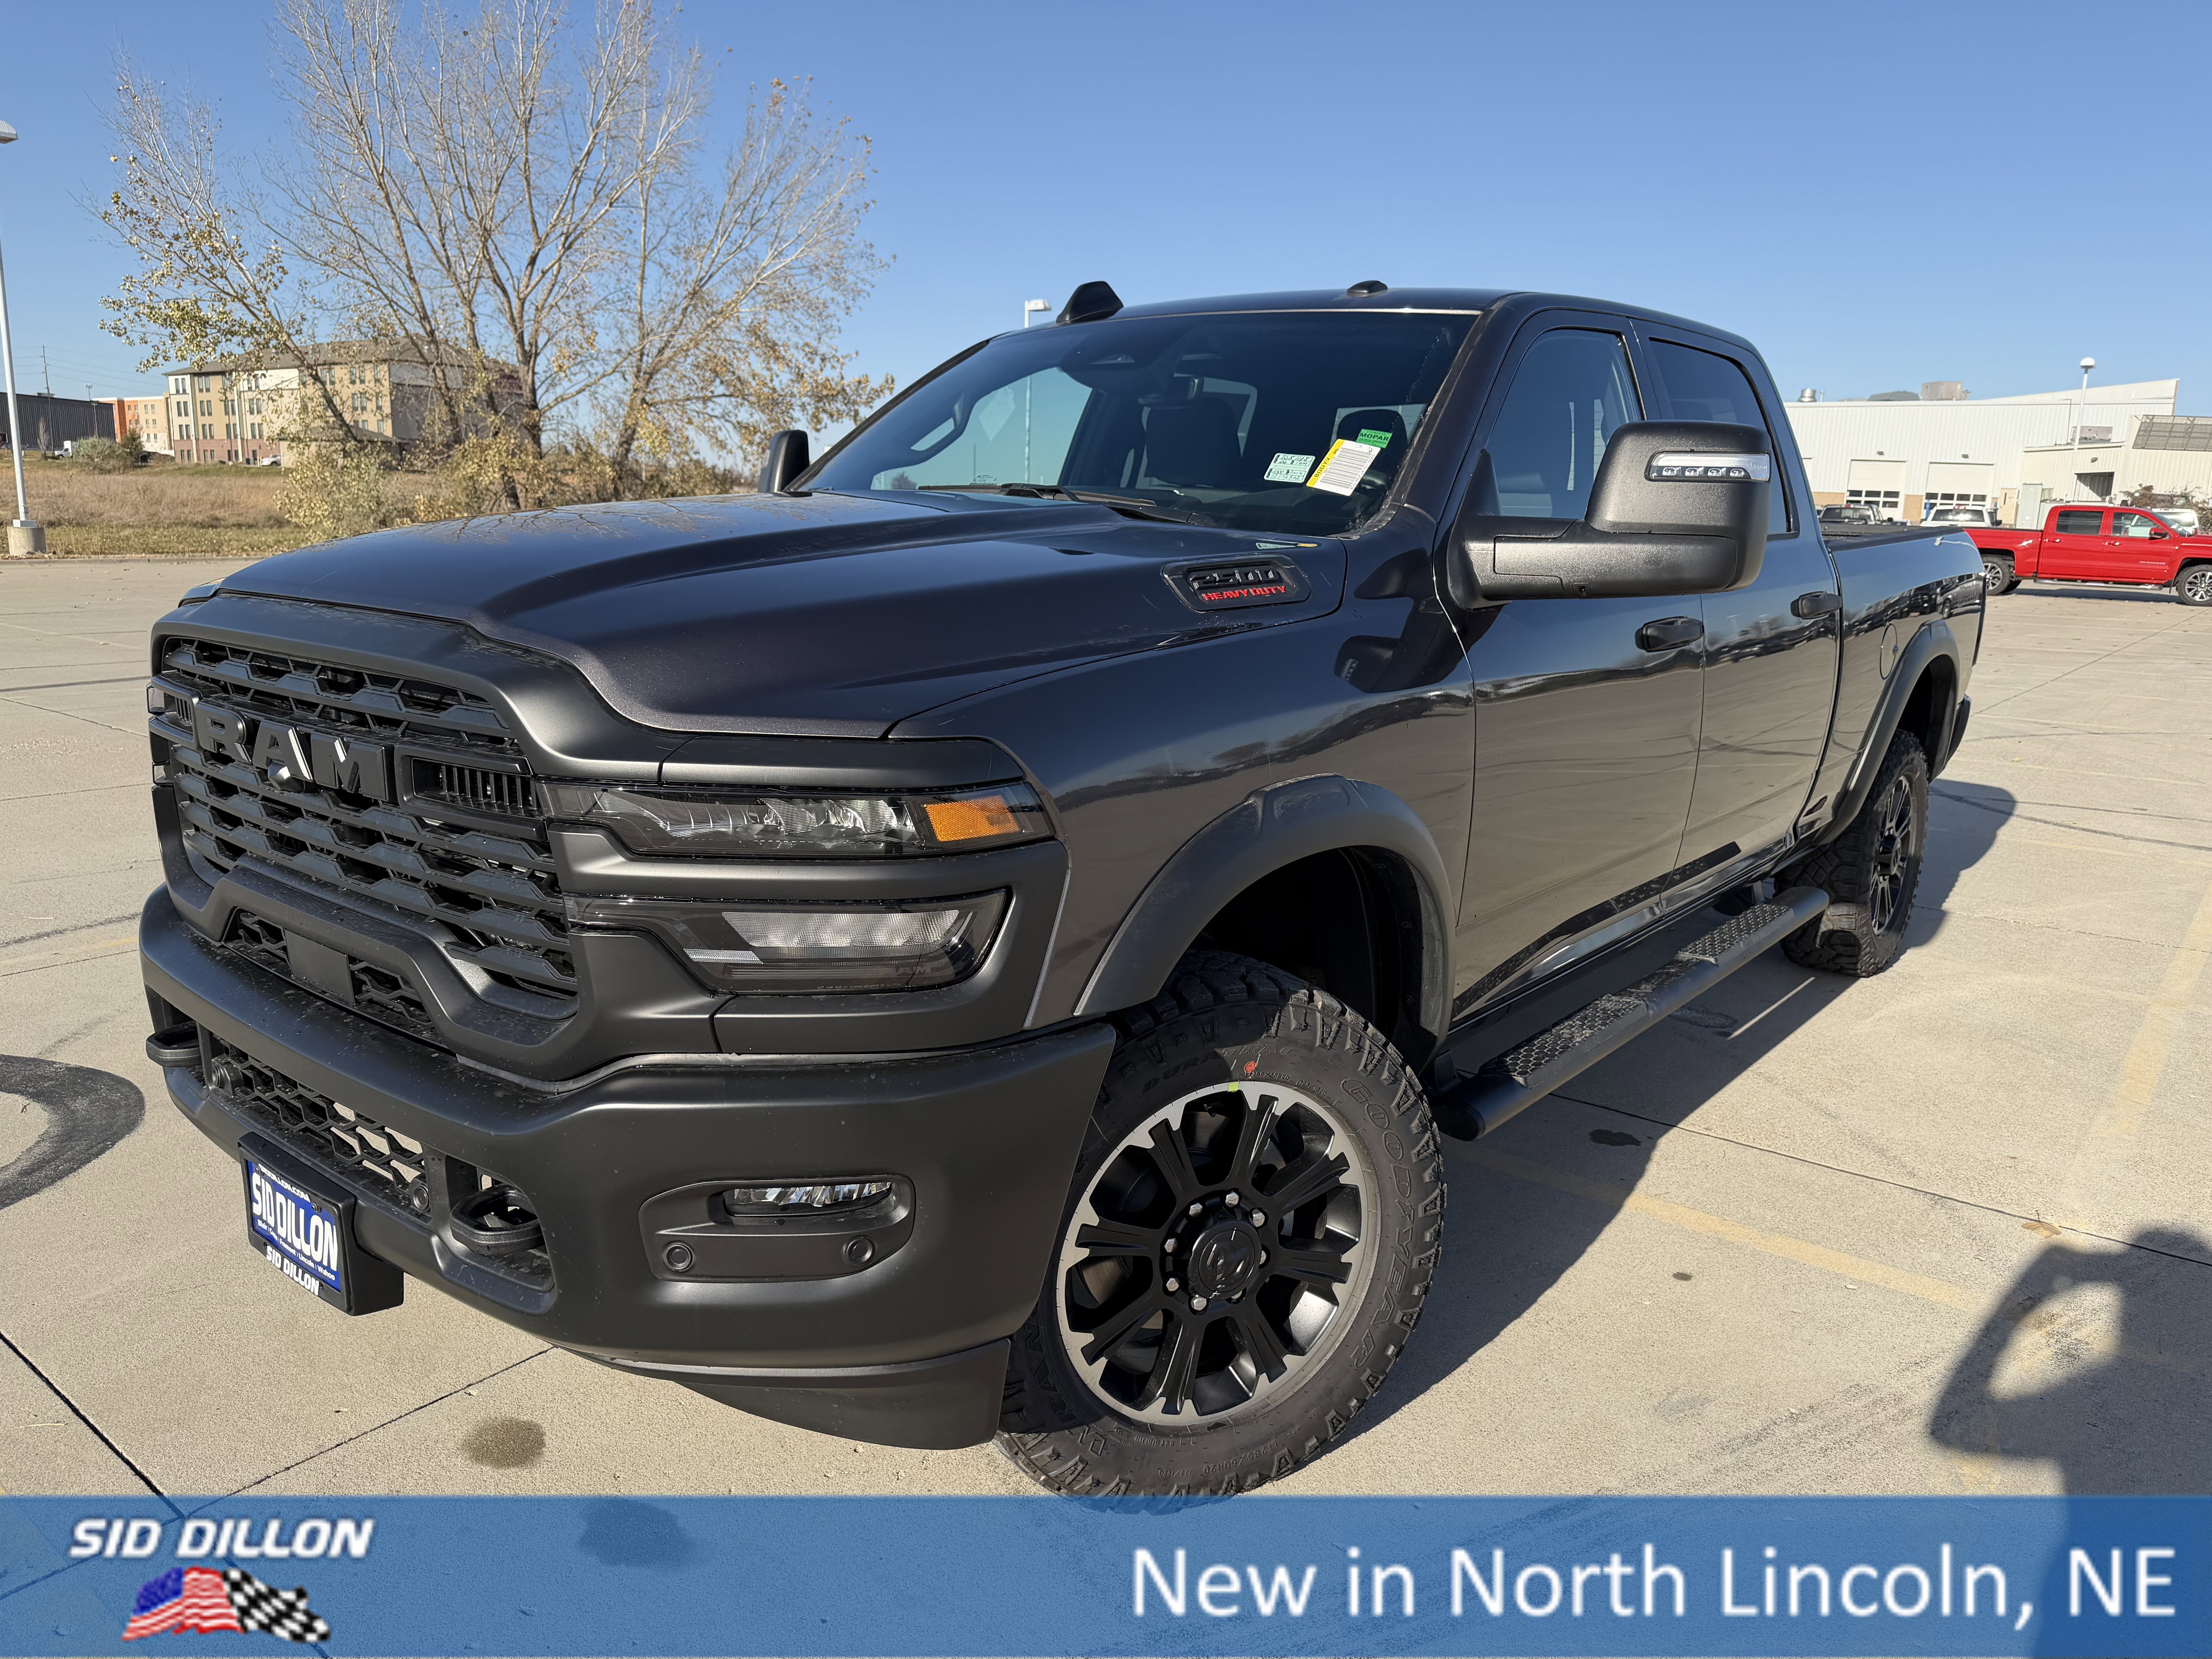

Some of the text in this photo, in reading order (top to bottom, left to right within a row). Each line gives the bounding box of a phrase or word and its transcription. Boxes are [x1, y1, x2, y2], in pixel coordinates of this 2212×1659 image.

[1359, 433, 1389, 441] MOPAR
[1190, 569, 1279, 590] 2500
[1201, 586, 1286, 601] HEAVY DUTY
[195, 700, 387, 802] RAM
[252, 1172, 338, 1271] SID DILLON
[1340, 1078, 1414, 1368] GOODYEAR
[266, 1245, 319, 1296] SID DILLON
[280, 1238, 296, 1256] Fremont
[299, 1252, 315, 1269] Lincoln
[317, 1265, 335, 1281] Wahoo
